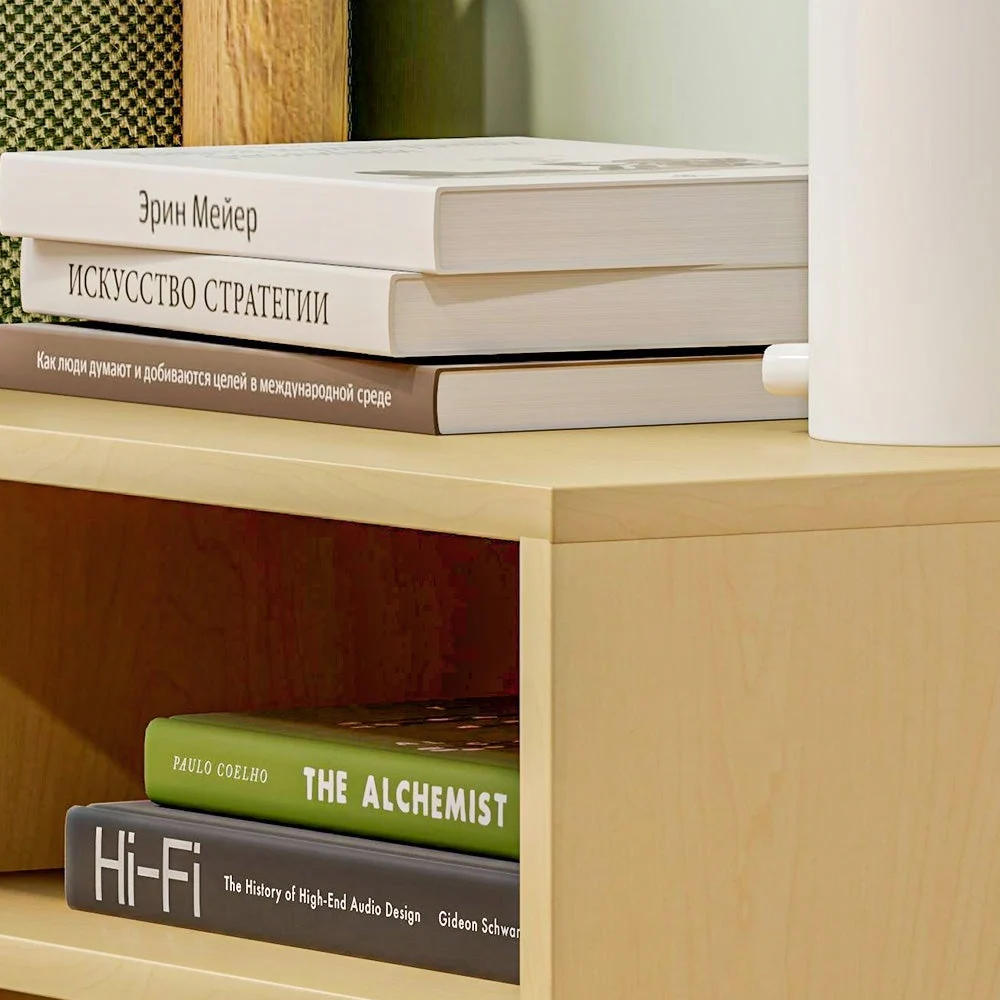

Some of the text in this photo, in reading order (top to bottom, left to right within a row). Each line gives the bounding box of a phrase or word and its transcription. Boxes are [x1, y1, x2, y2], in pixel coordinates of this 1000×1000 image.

[139, 189, 258, 243] Эрин Мейер
[68, 263, 329, 326] ИСКУССТВО СТРАТЕГИИ
[36, 350, 392, 409] Как люди думают и добиваются целей в международной среде
[172, 755, 268, 784] PAULO COELHO
[303, 766, 508, 828] THE ALCHEMIST
[94, 826, 201, 918] Hi-Fi
[223, 874, 421, 926] The History of High-End Audio Design
[438, 910, 478, 932] Gideon
